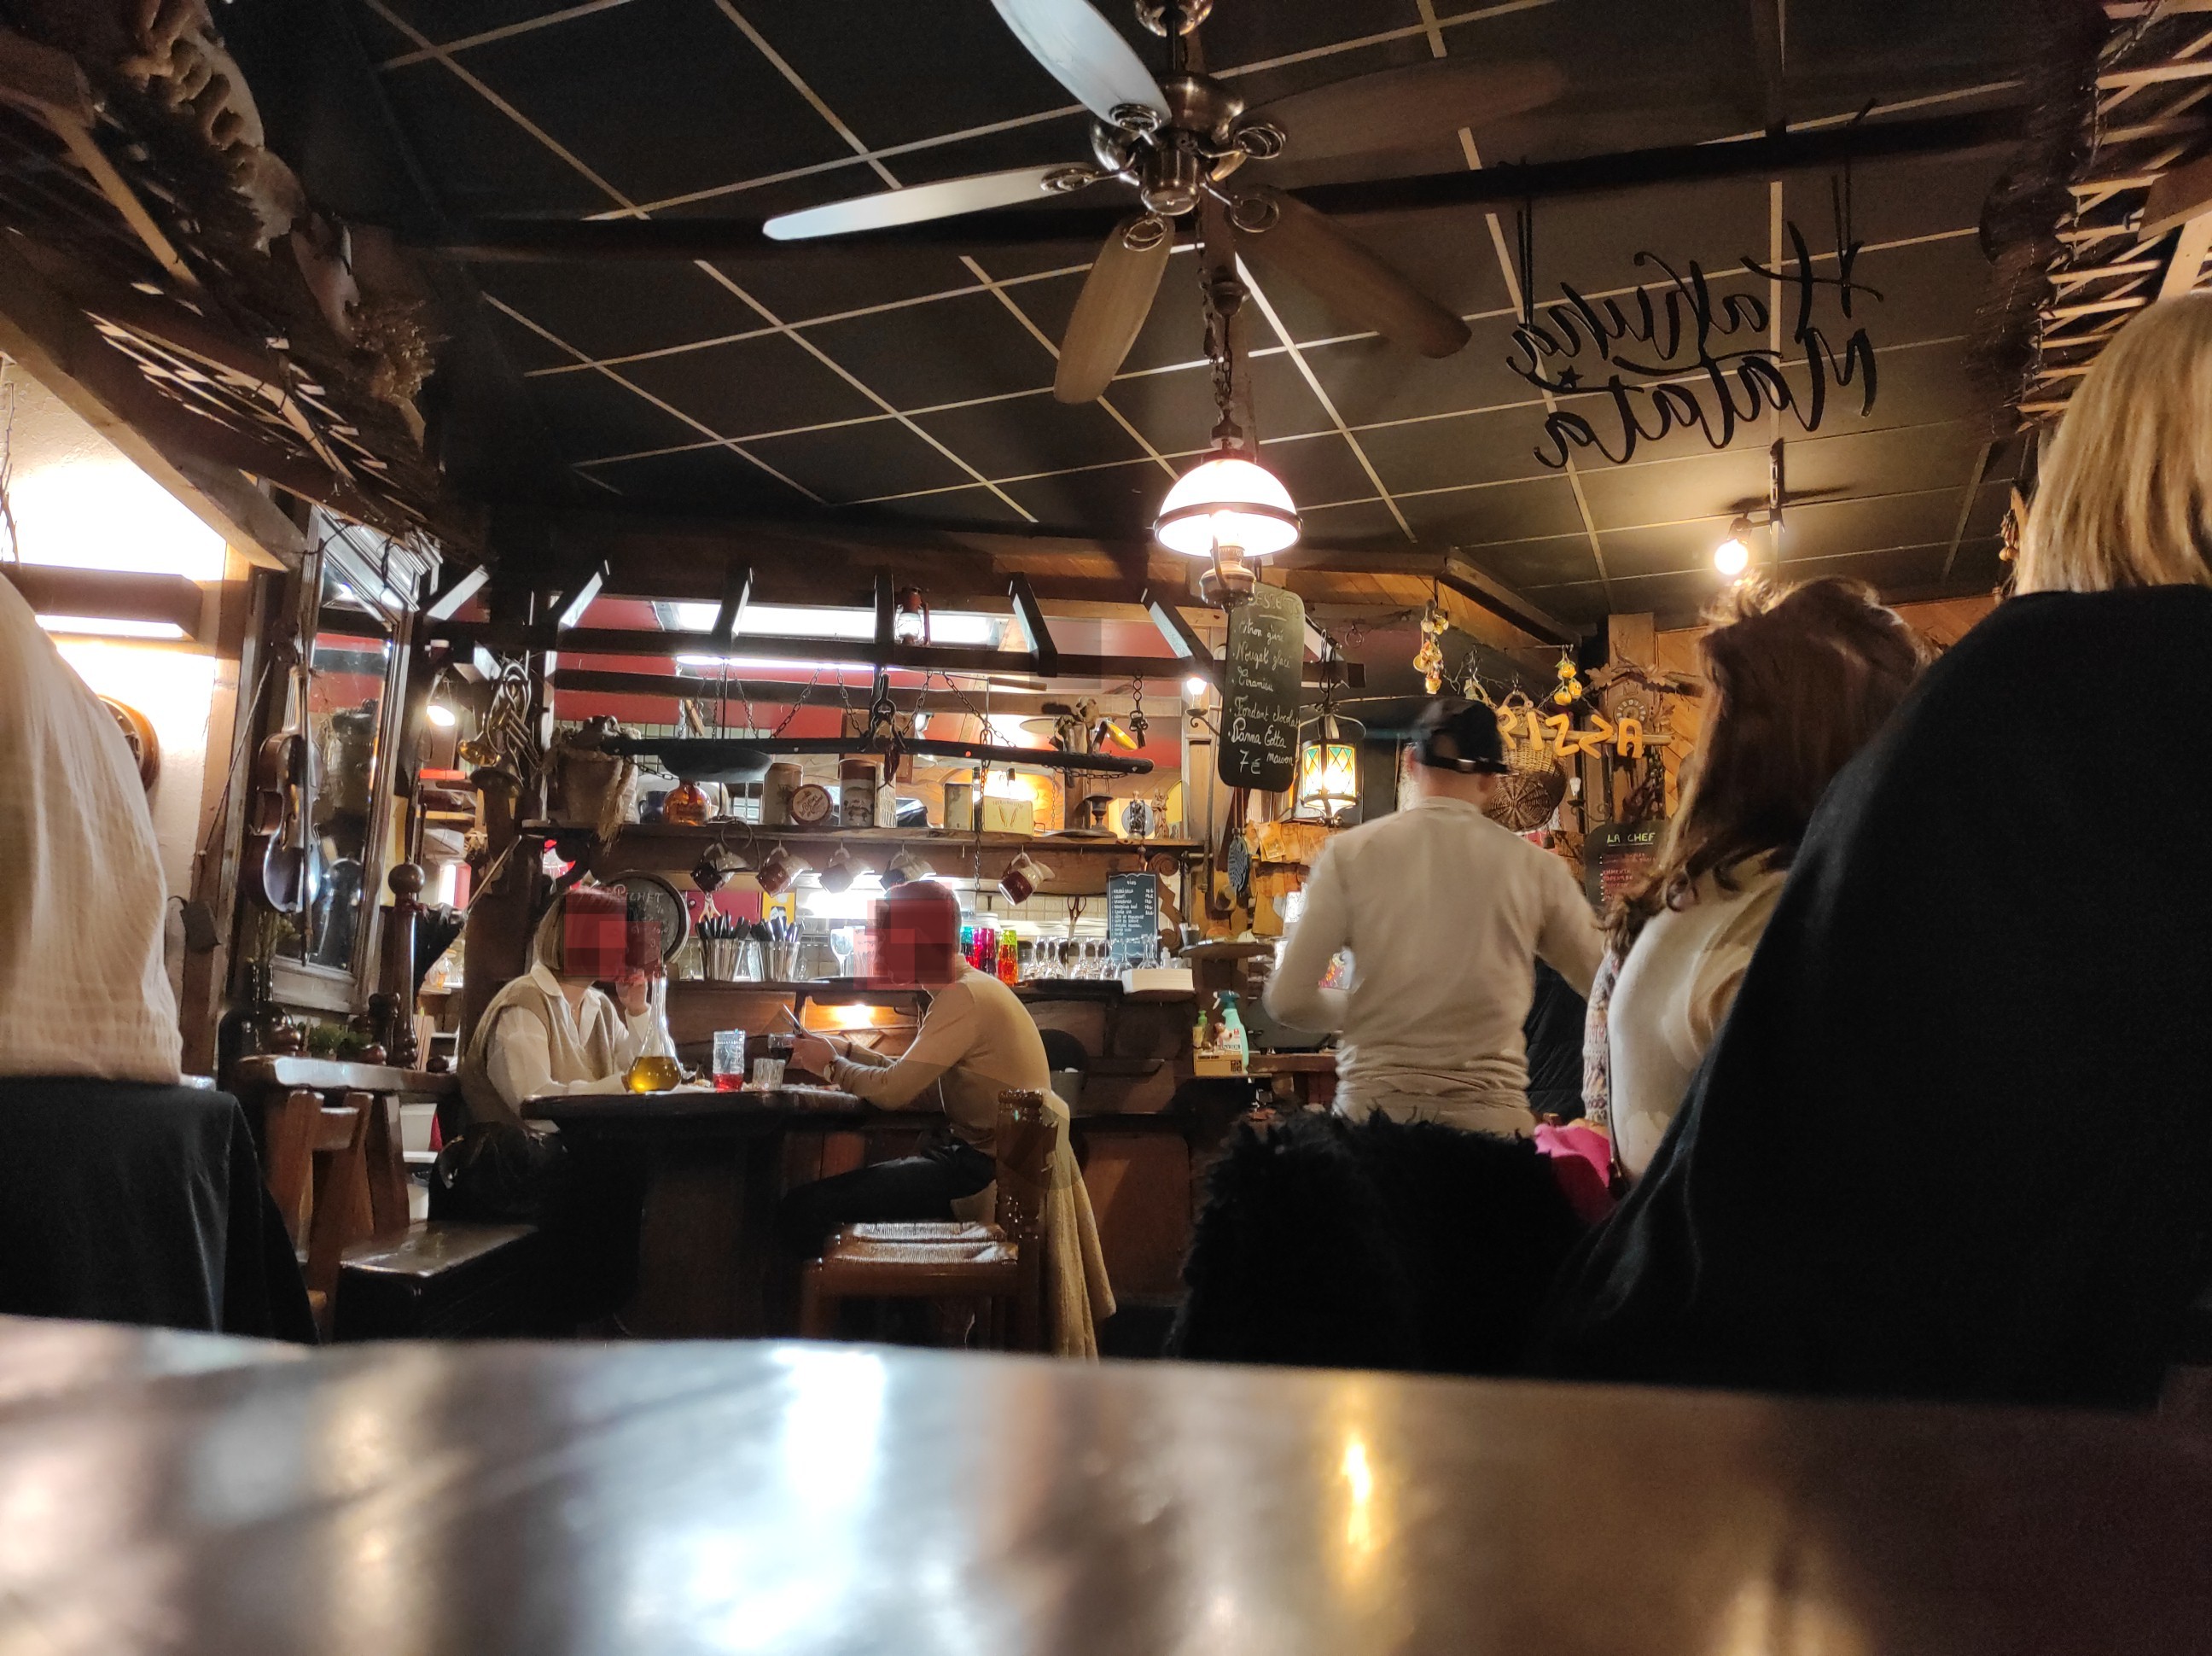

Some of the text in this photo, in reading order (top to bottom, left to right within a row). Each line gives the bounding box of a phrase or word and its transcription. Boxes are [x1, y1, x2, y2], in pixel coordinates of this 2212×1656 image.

[1235, 642, 1269, 670] Nougat
[1237, 666, 1274, 691] Tiramisu
[1234, 695, 1269, 721] Fondant
[1231, 717, 1261, 745] Panna
[1496, 705, 1644, 759] PIZZA
[1266, 752, 1294, 766] maison
[1606, 832, 1656, 843] LA CHEF
